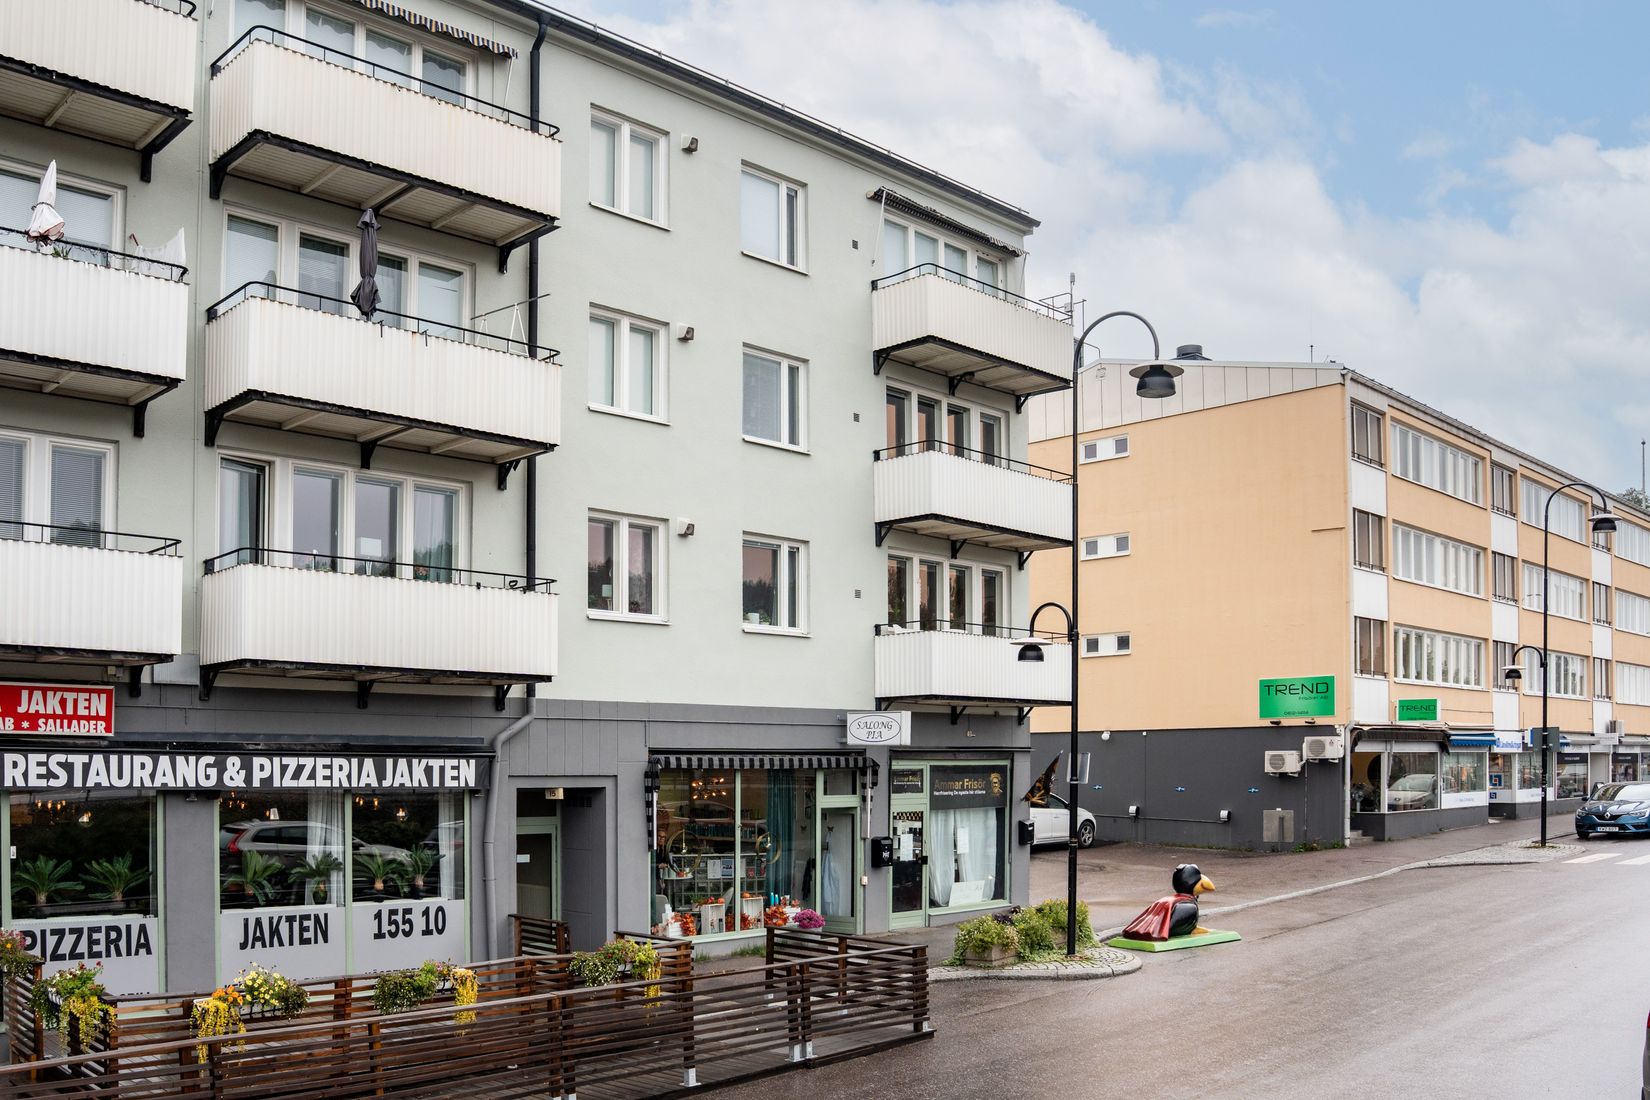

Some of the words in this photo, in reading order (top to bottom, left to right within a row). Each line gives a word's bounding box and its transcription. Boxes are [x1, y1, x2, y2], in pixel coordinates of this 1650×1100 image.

[1264, 682, 1328, 696] TREND
[17, 689, 106, 716] JAKTEN
[38, 718, 106, 734] SALLADER
[856, 720, 893, 731] SALONG
[866, 731, 883, 739] PIA
[3, 753, 218, 787] RESTAURANG
[223, 755, 246, 787] &
[252, 757, 379, 787] PIZZERIA
[382, 758, 476, 787] JAKTEN
[934, 779, 962, 790] Ammar
[964, 778, 986, 789] Frisör
[239, 913, 328, 950] JAKTEN
[373, 907, 414, 940] 155
[421, 905, 446, 936] 10
[20, 923, 152, 963] PIZZERIA
